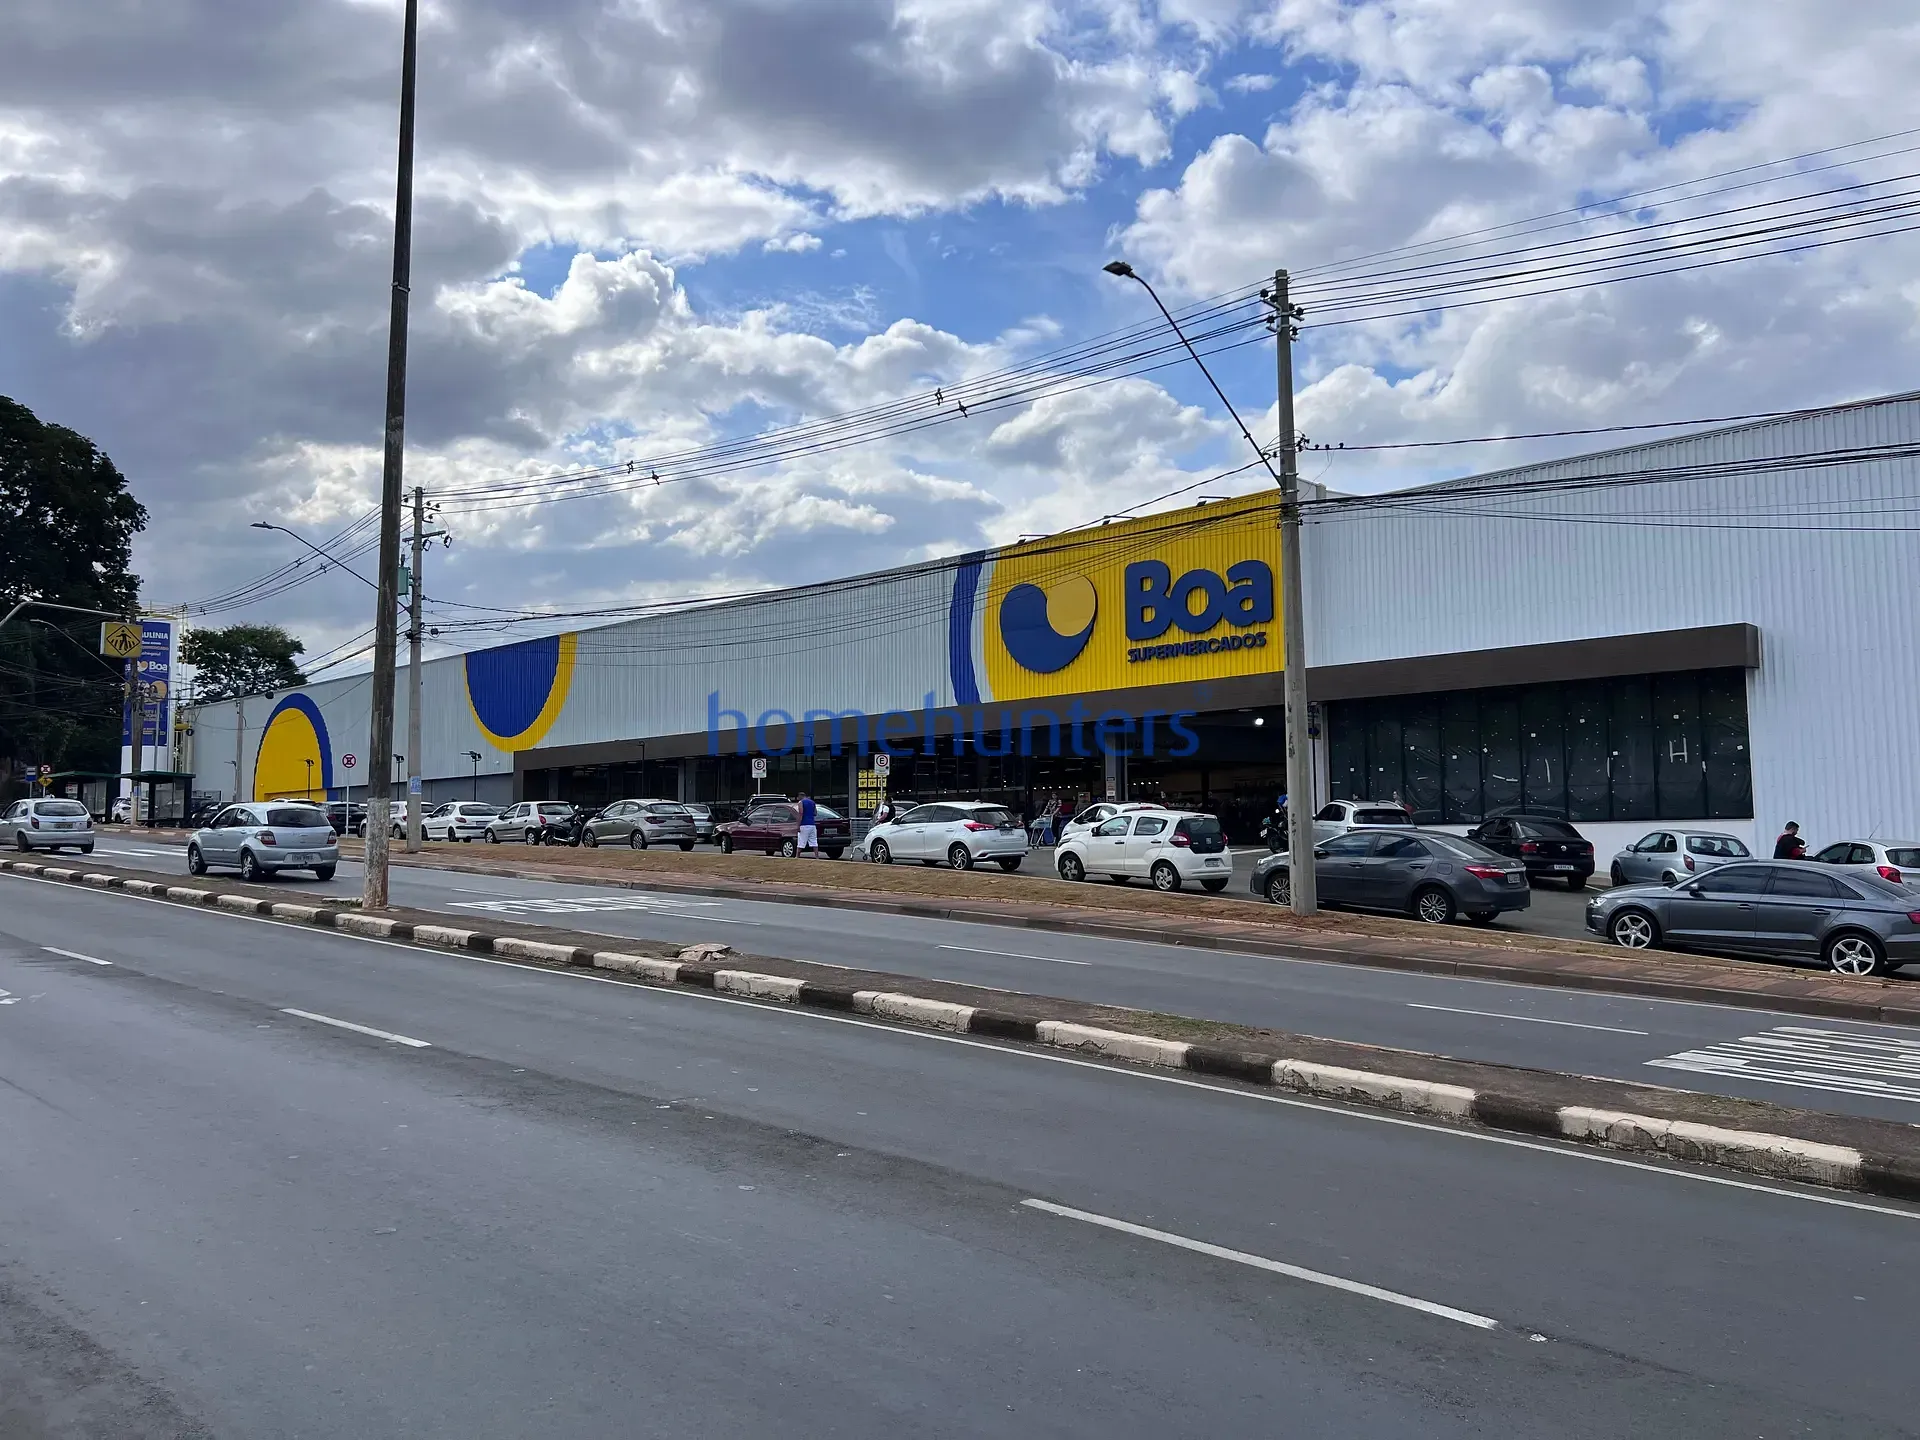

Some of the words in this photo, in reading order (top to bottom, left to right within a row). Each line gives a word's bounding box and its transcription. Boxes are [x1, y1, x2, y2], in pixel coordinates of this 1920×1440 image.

[1124, 559, 1274, 641] Boa
[1127, 631, 1267, 663] SUPERMERCADOS
[149, 661, 168, 671] Boa
